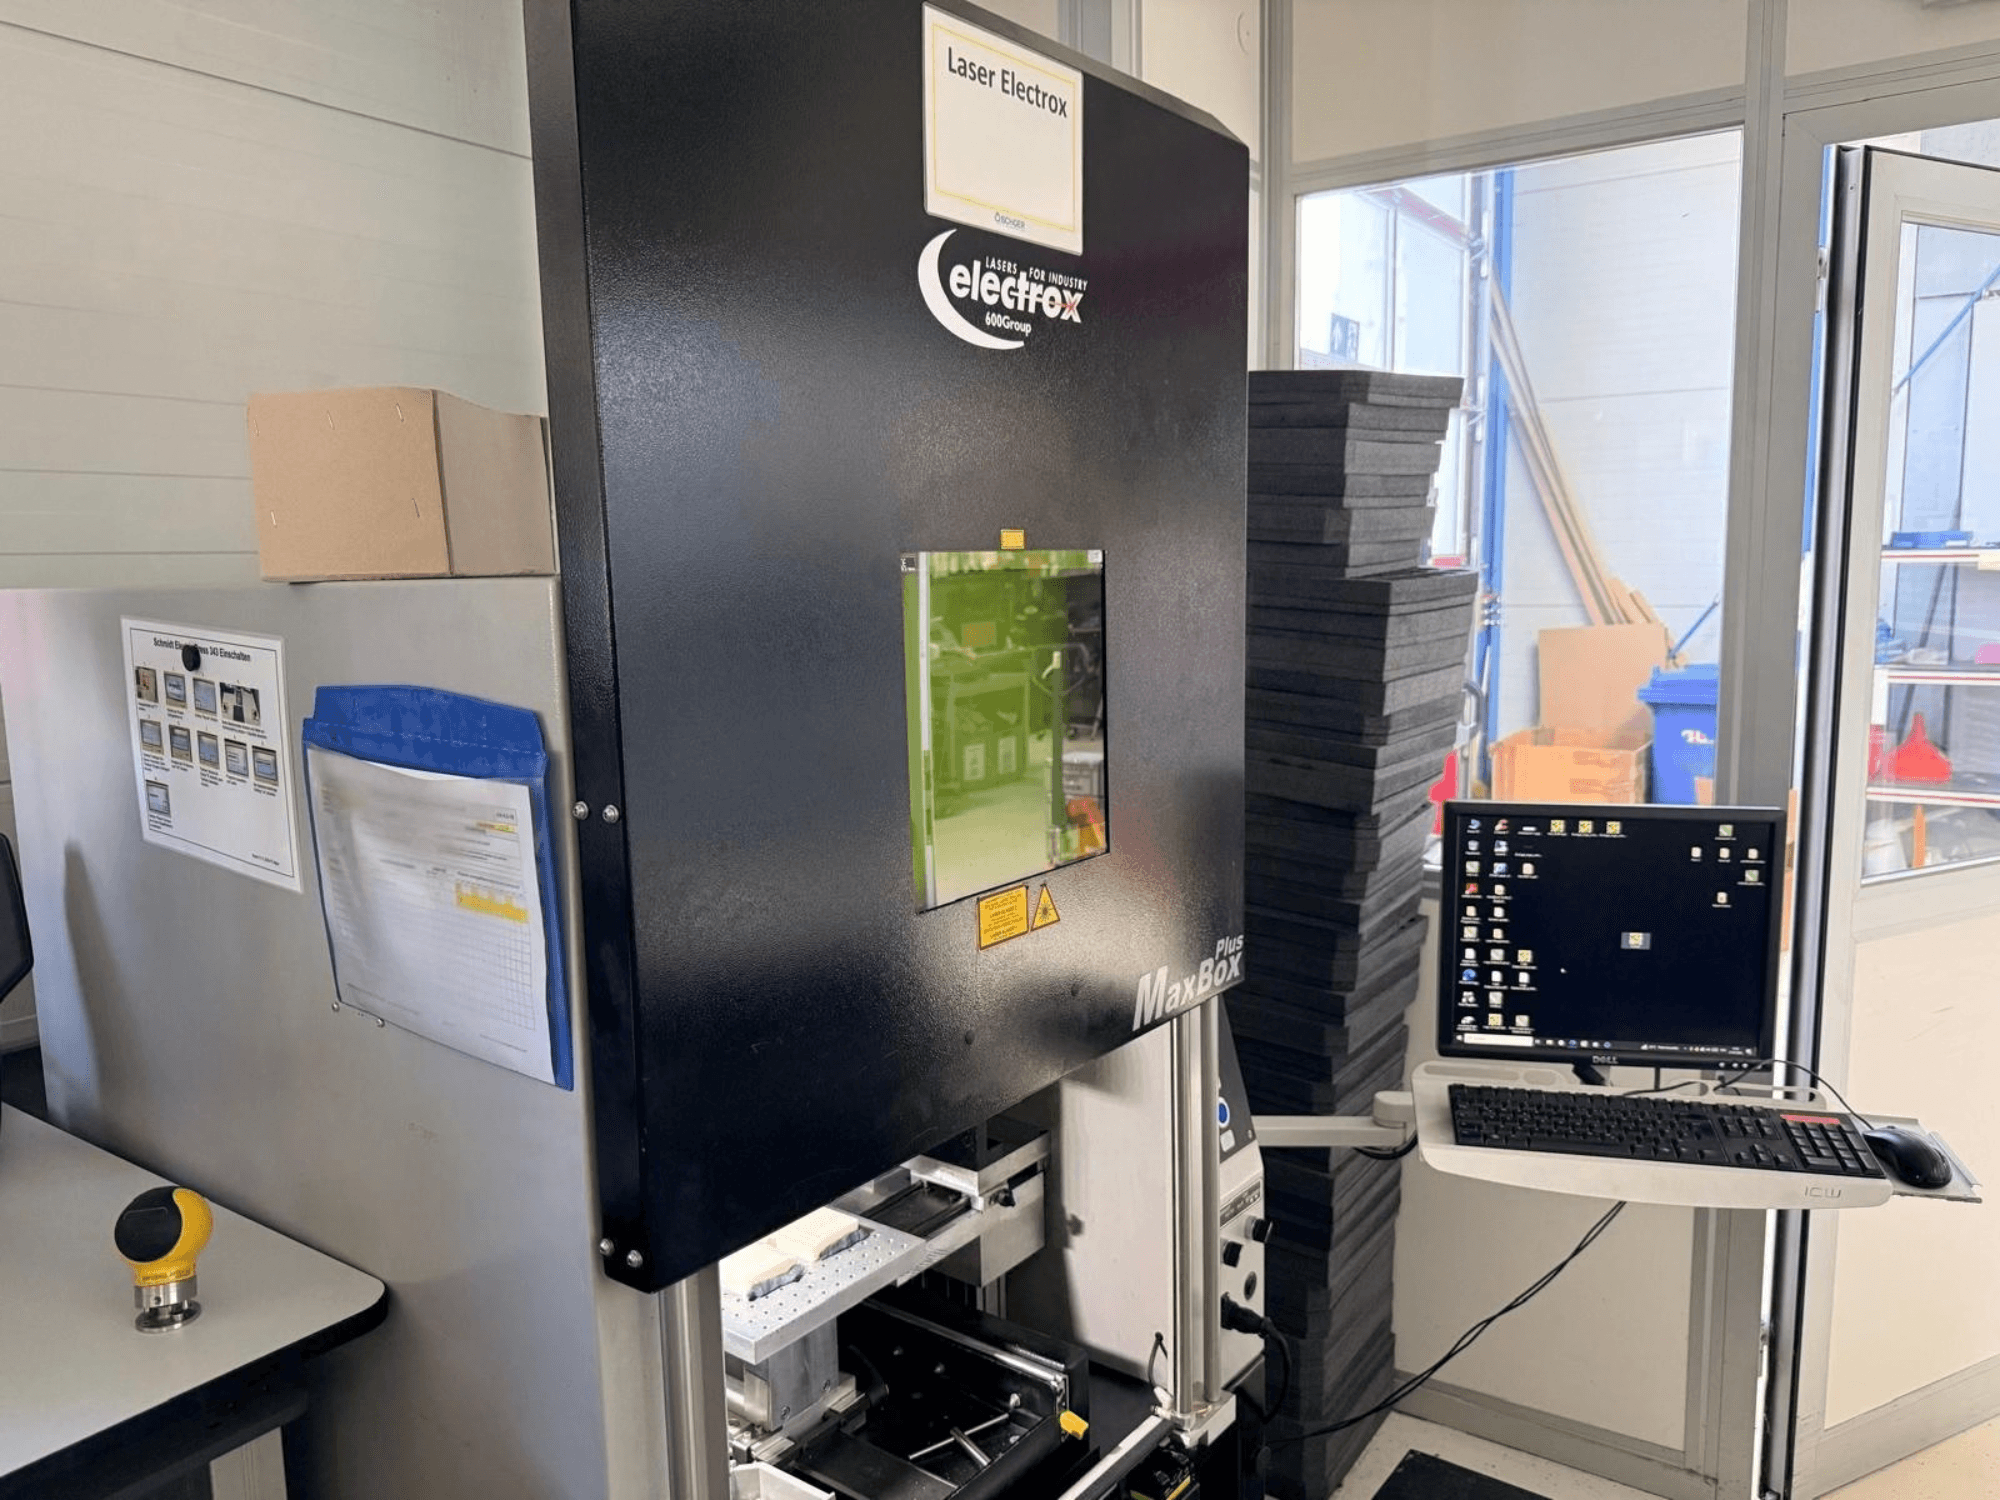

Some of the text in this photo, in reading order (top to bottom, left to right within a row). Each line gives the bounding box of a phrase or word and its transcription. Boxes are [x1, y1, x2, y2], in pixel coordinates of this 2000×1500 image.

[948, 46, 1067, 118] Laser Electrox
[949, 259, 1084, 323] electrox
[985, 255, 1088, 291] LASERS FOR INDUSTRY
[985, 311, 1032, 337] 600Group
[1215, 935, 1244, 960] Plus
